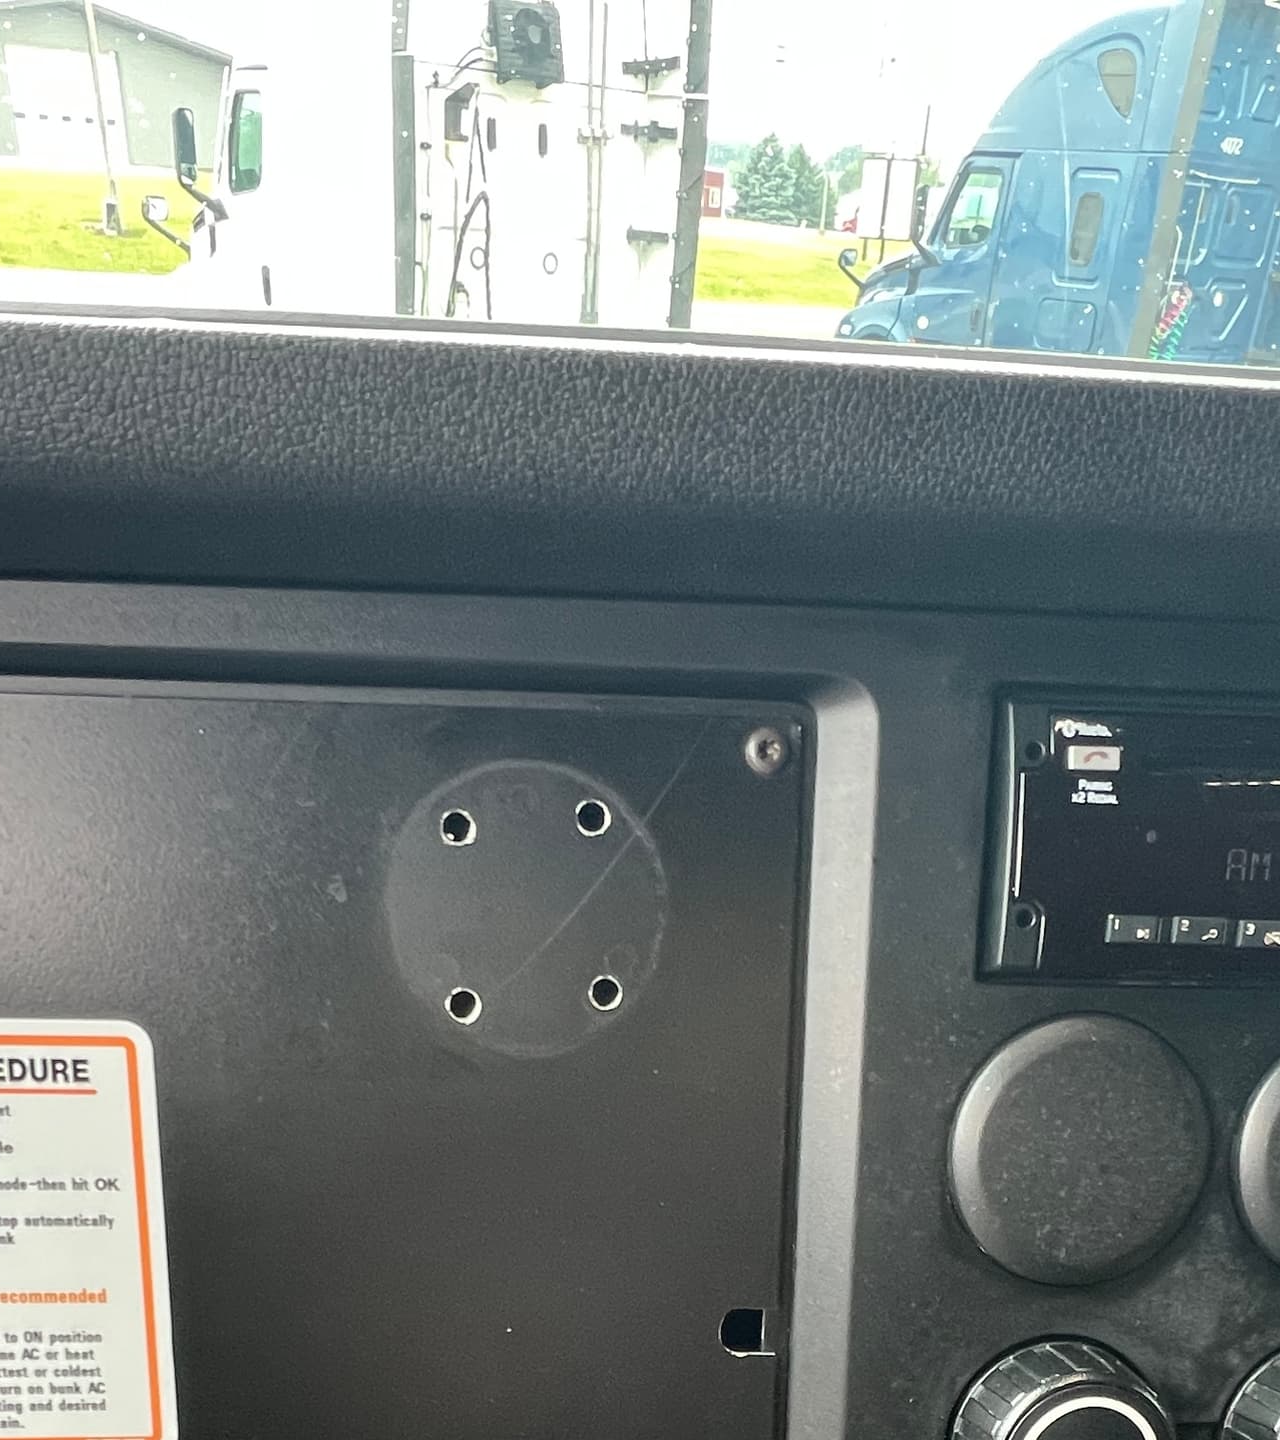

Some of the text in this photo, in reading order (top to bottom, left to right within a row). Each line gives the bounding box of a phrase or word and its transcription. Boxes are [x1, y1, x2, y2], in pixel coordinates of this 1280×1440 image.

[1225, 849, 1272, 881] AM
[1180, 919, 1190, 932] 2
[1246, 922, 1255, 935] 3
[94, 1178, 120, 1191] OK
[24, 1214, 114, 1230] automatically
